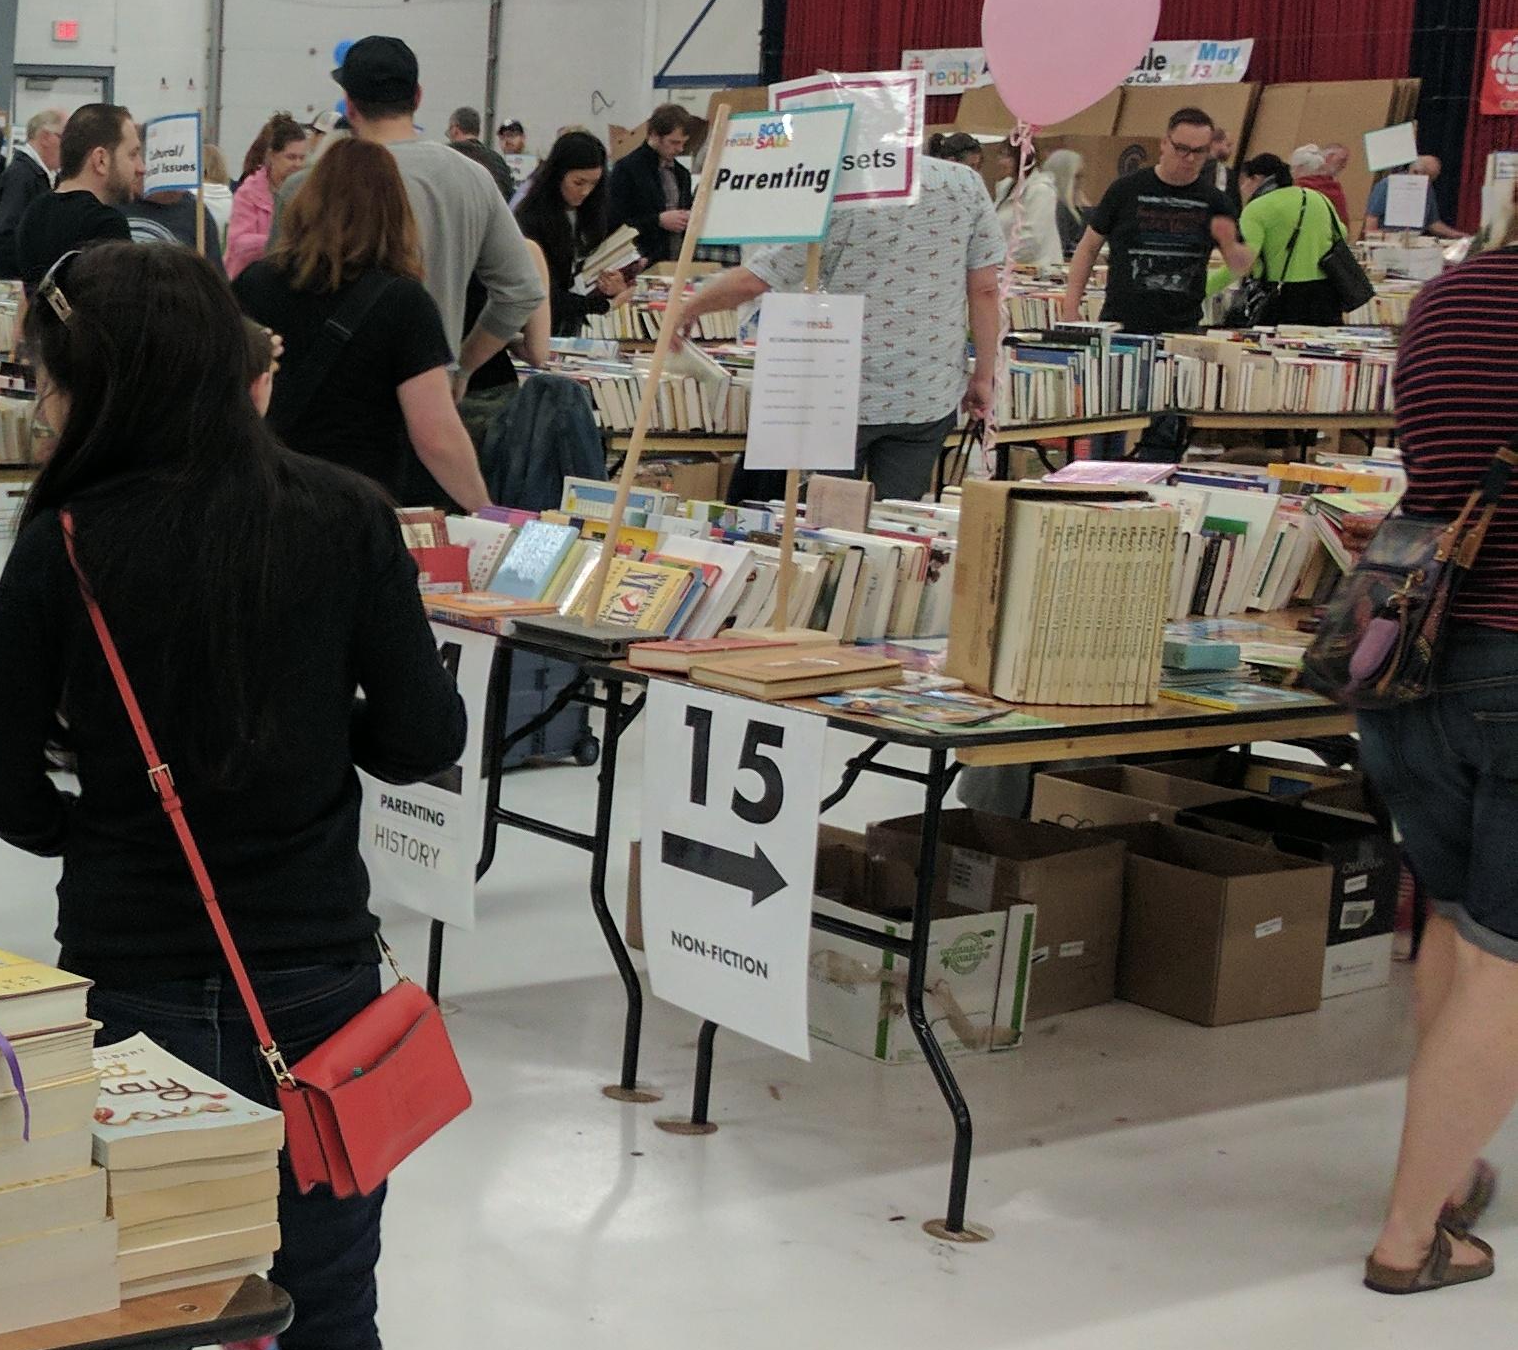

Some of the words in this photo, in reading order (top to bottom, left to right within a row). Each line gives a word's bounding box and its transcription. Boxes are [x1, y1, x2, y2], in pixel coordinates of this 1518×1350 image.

[1198, 42, 1241, 65] May
[928, 61, 978, 87] reads
[1136, 73, 1162, 84] Club
[758, 121, 794, 136] BOO
[162, 162, 196, 173] Issues
[841, 148, 897, 171] sets
[714, 162, 831, 193] Parenting
[684, 705, 785, 826] 15
[380, 793, 446, 828] PARENTING
[373, 823, 441, 870] HISTORY
[670, 929, 770, 980] NON-FICTION
